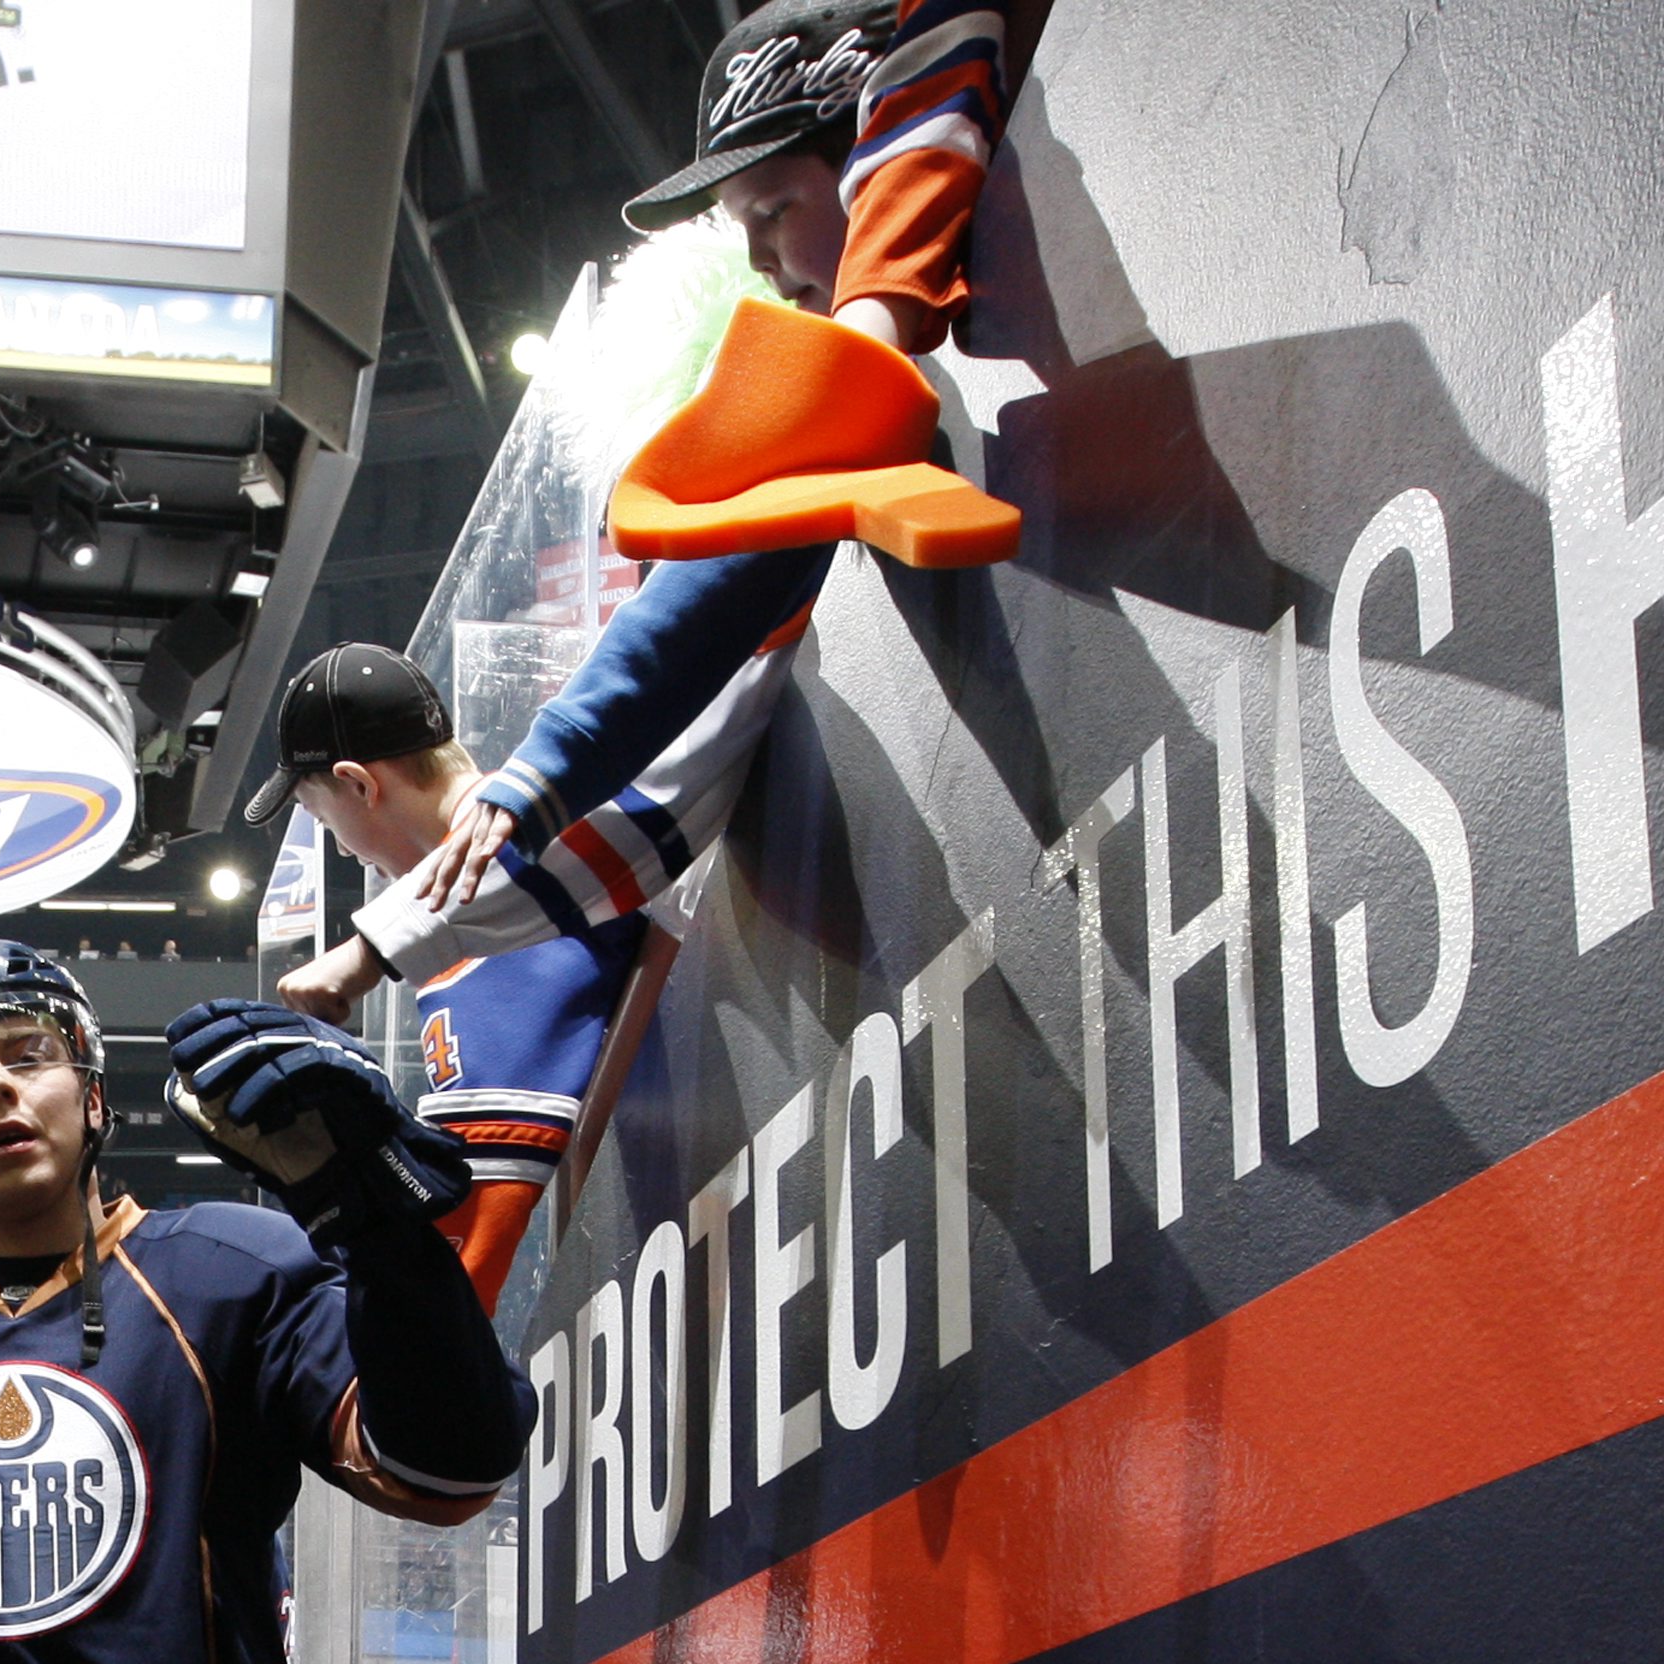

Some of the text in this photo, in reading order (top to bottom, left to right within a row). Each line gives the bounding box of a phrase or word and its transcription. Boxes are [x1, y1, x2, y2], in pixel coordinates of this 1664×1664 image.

[708, 27, 882, 128] Hurley
[526, 905, 996, 1636] PROTECT
[1042, 486, 1474, 1275] THIS
[377, 1144, 433, 1203] EDMONTON
